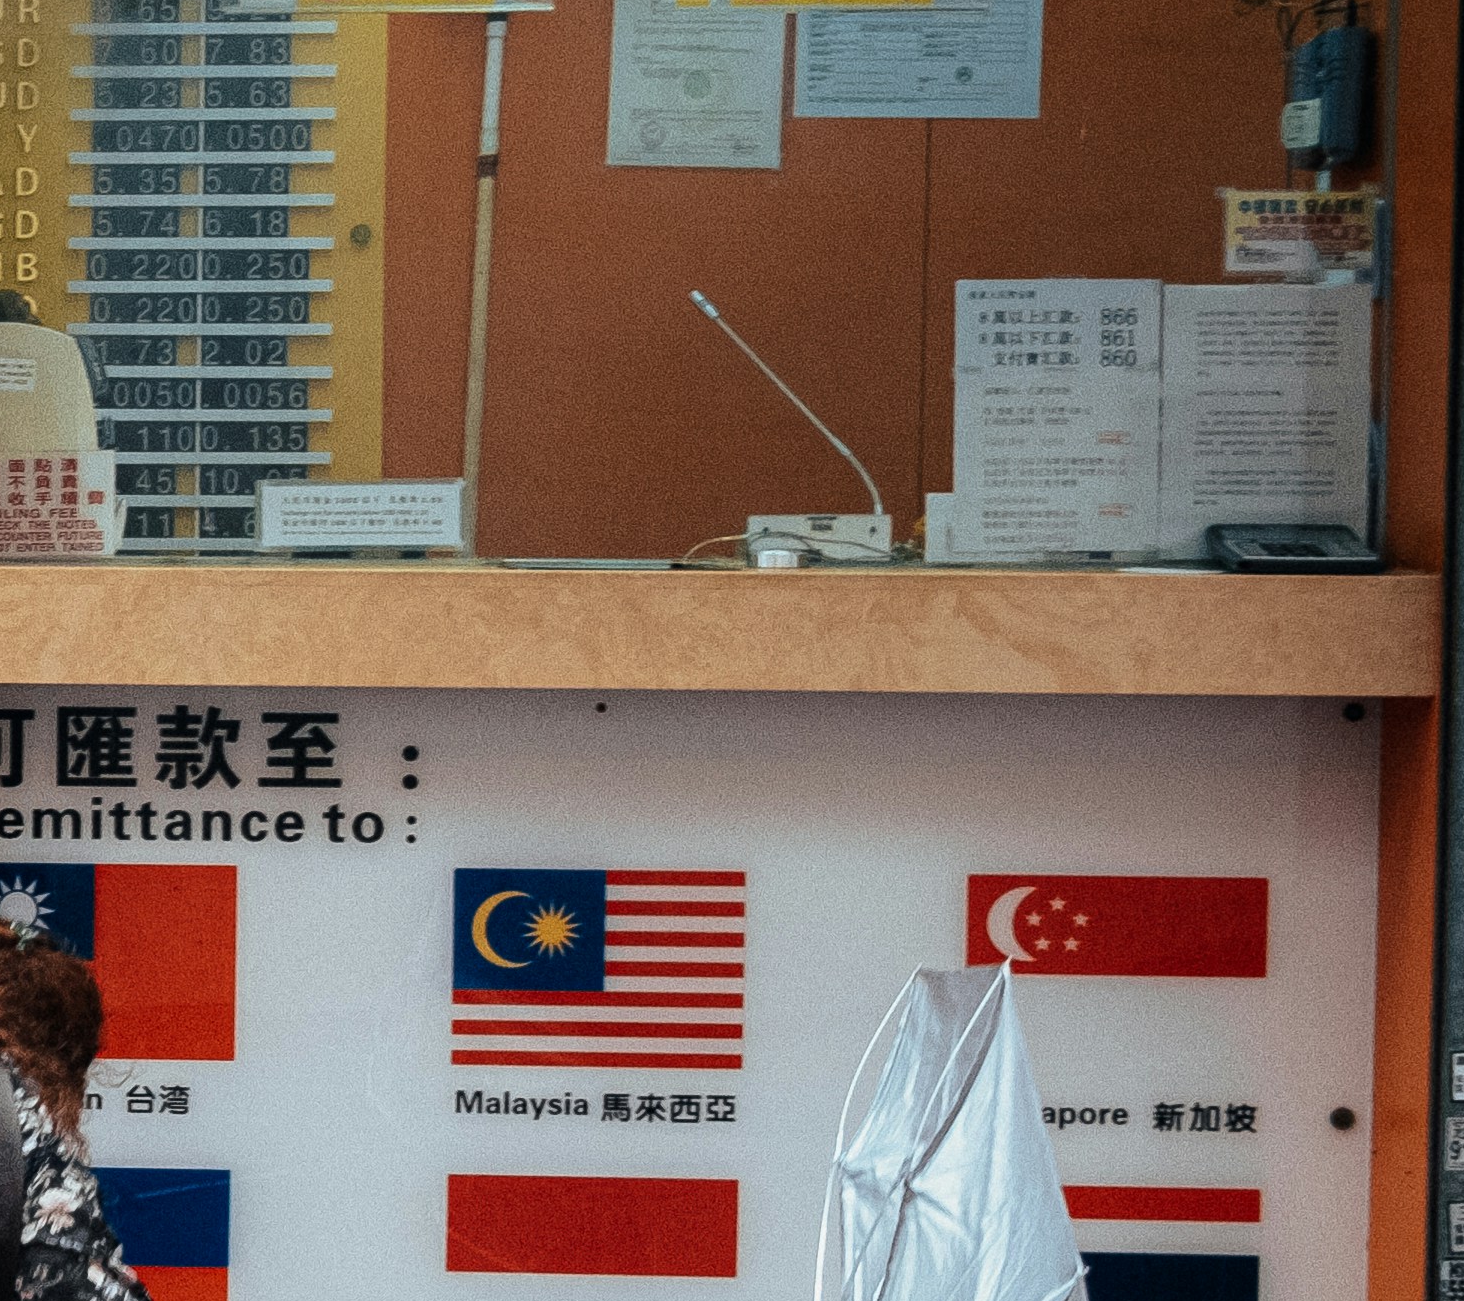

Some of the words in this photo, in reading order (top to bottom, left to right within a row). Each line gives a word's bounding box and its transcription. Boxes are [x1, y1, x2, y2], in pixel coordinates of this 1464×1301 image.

[454, 1089, 589, 1123] Malaysia
[600, 1092, 737, 1125] 馬來西亞
[1040, 1102, 1130, 1130] apore
[1152, 1102, 1259, 1133] 新加坡
